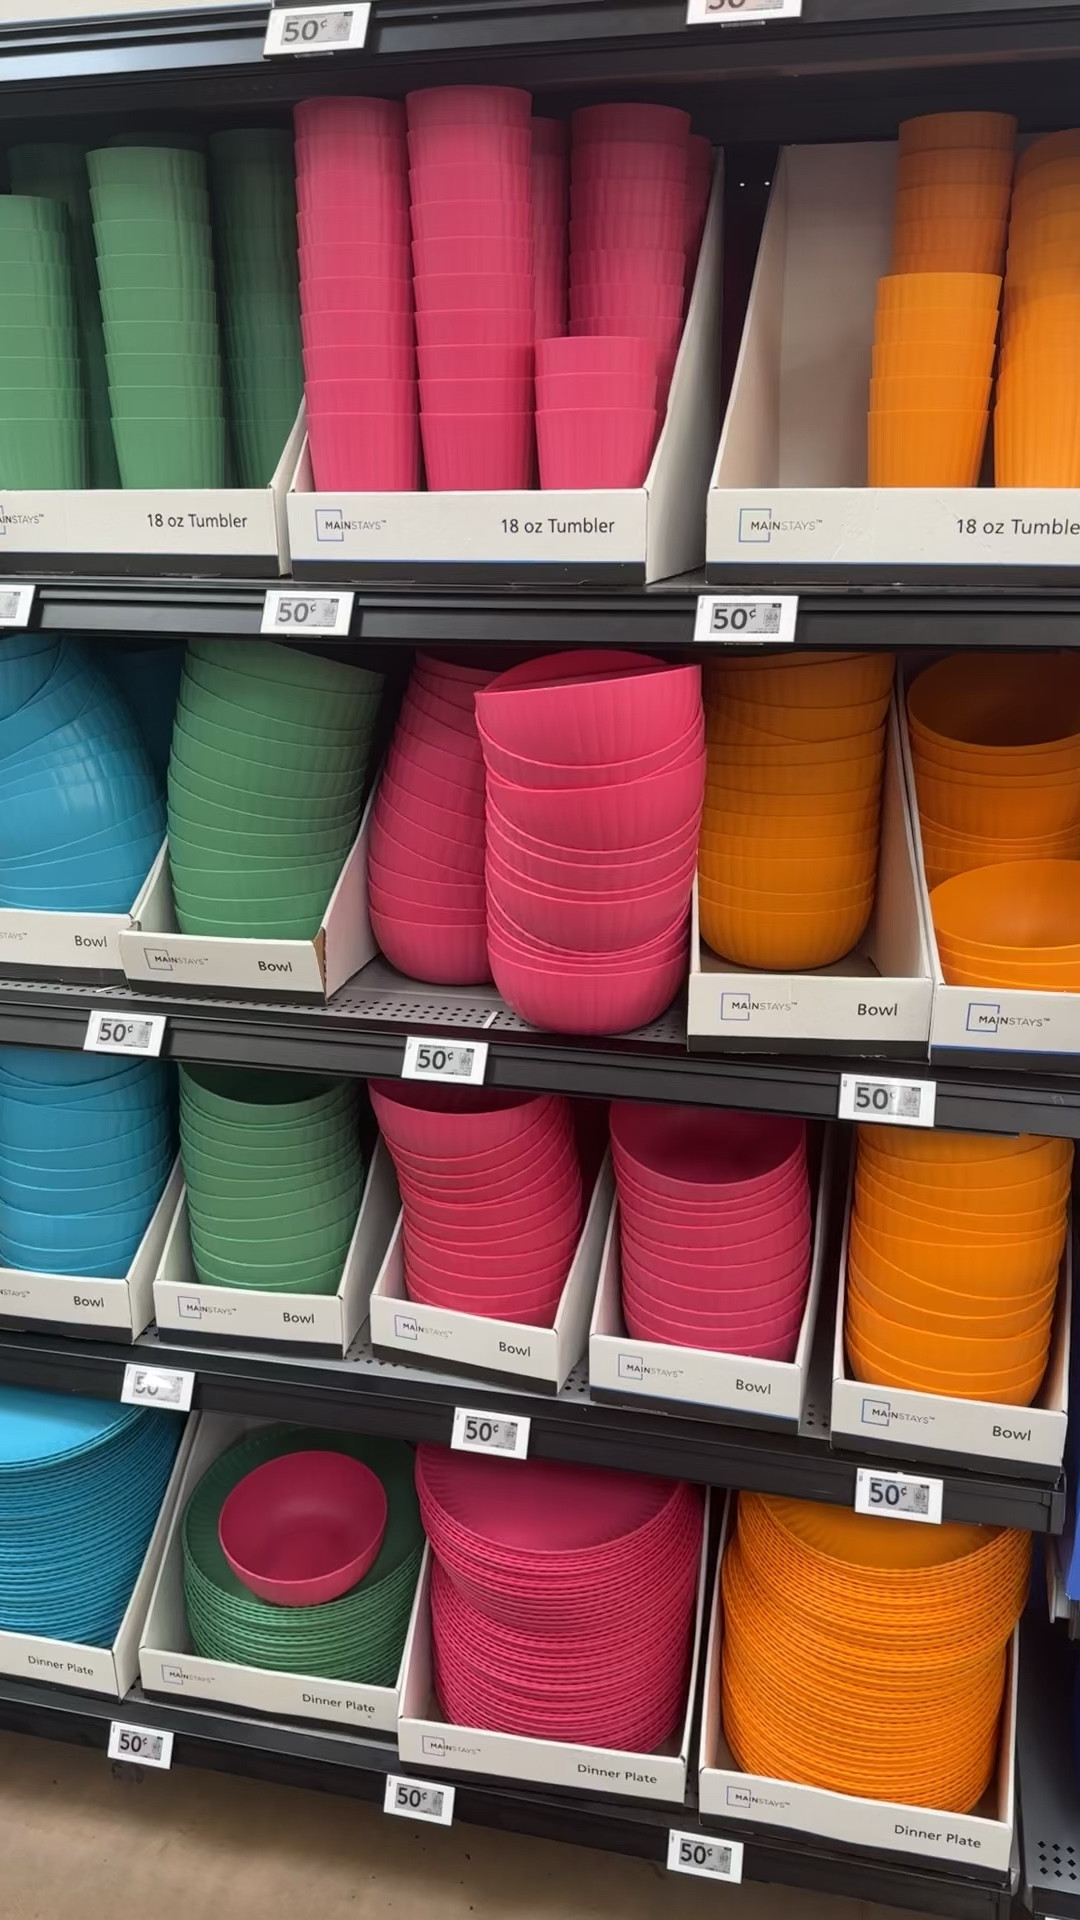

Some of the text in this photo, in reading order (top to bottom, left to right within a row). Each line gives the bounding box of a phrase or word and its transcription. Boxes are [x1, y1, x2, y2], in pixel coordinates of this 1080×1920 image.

[147, 513, 248, 528] 18 oz Tumbler
[502, 517, 615, 533] 18 oz Tumbler
[957, 518, 1080, 535] 18 oz Tumble
[75, 935, 107, 947] Bowl
[258, 961, 292, 972] Bowl
[858, 1003, 898, 1016] Bowl
[73, 1296, 104, 1307] Bowl
[283, 1312, 314, 1324] Bowl
[499, 1341, 530, 1357] Bowl
[736, 1379, 771, 1395] Bowl
[992, 1426, 1031, 1441] Bowl
[28, 1655, 94, 1676] Dinner Plate
[302, 1694, 376, 1713] Dinner Plate
[578, 1764, 657, 1783] Dinner Plate
[894, 1825, 981, 1848] Dinner Plate
